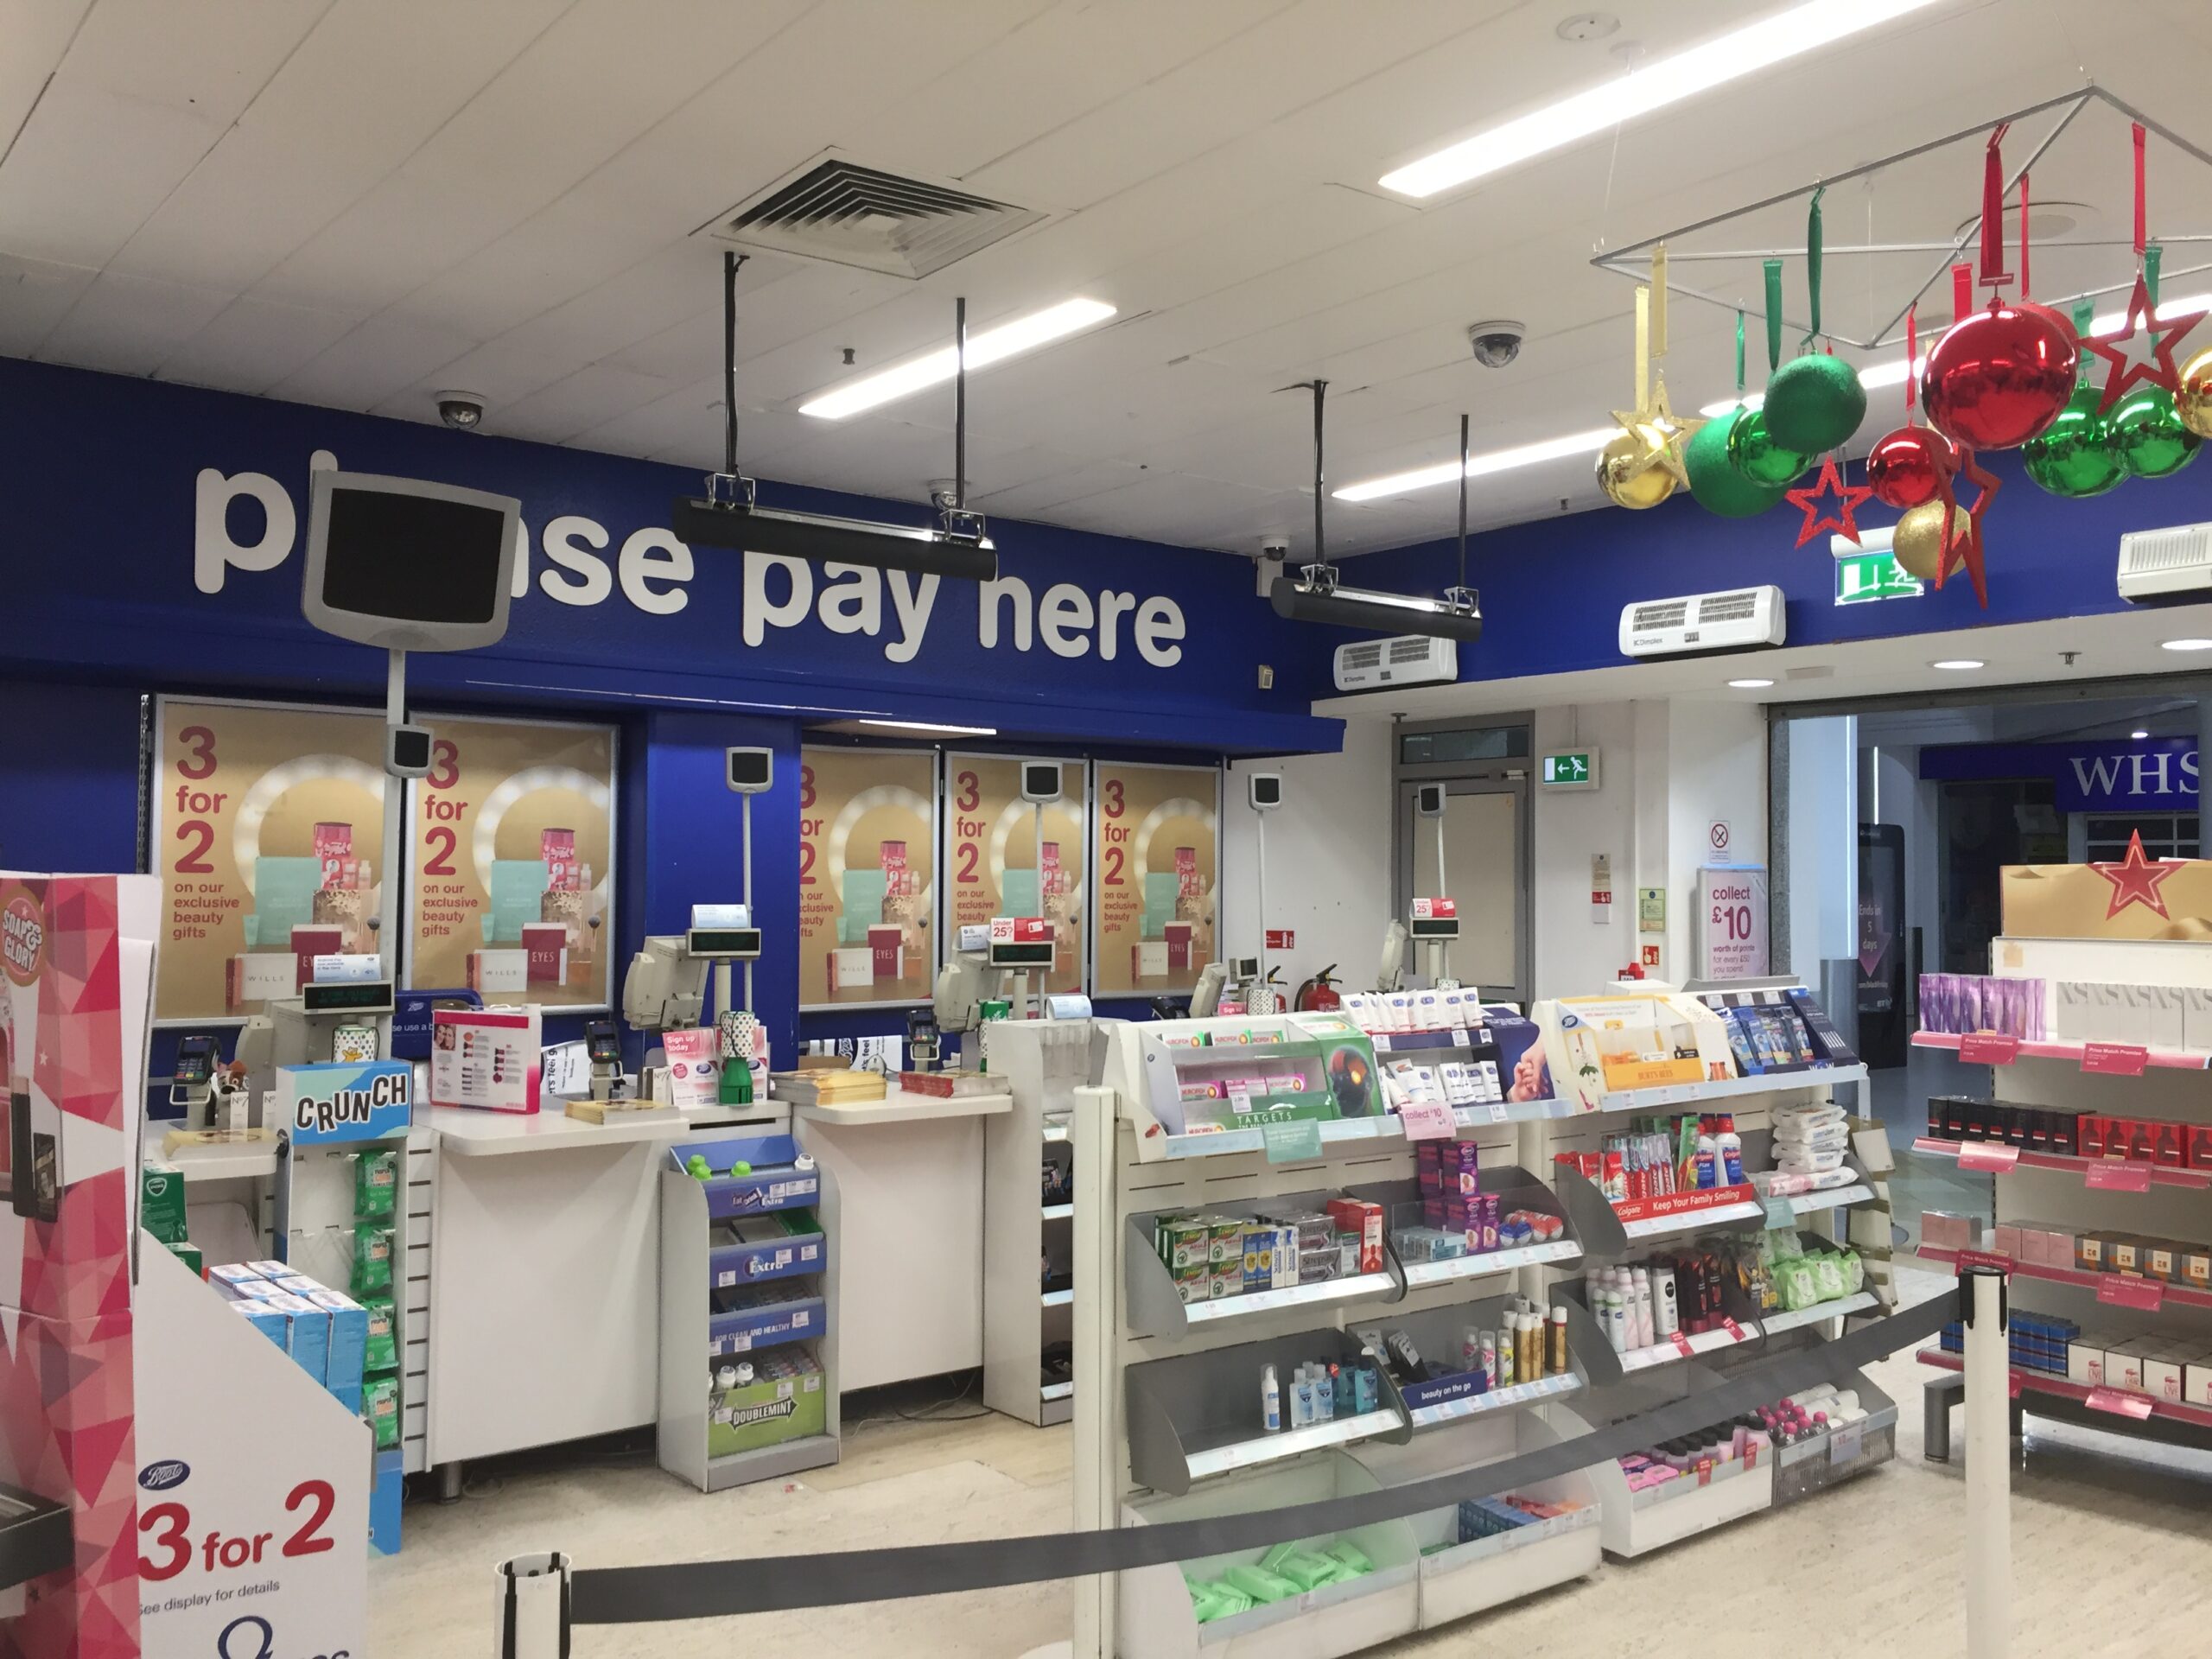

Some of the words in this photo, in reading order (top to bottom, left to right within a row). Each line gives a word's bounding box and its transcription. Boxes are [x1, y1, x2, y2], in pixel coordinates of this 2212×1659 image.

[194, 449, 694, 614] pse
[743, 550, 941, 663] pay
[979, 575, 1185, 667] here
[176, 725, 218, 779] 3
[428, 739, 460, 790] 3
[957, 771, 980, 812] 3
[1104, 779, 1125, 818] 3
[176, 785, 227, 814] for
[424, 795, 468, 821] for
[801, 817, 824, 836] or
[957, 817, 986, 838] for
[1104, 823, 1130, 842] for
[175, 820, 214, 874] 2
[423, 826, 456, 875] 2
[957, 842, 979, 883] 2
[1104, 847, 1124, 885] 2
[175, 884, 194, 893] on
[199, 884, 224, 893] our
[423, 884, 439, 893] on
[443, 884, 465, 893] our
[1713, 886, 1751, 900] collect
[174, 896, 239, 908] exclusive
[423, 896, 479, 907] exclusive
[807, 892, 823, 900] our
[957, 900, 995, 909] exclusive
[174, 912, 224, 925] beauty
[423, 910, 465, 924] beauty
[957, 912, 986, 922] beauty
[1104, 912, 1130, 923] beauty
[1712, 906, 1751, 940] £10
[3, 910, 27, 939] SOAP
[422, 925, 450, 938] gifts
[1104, 923, 1121, 933] gifts
[1866, 921, 1872, 932] 5
[173, 926, 207, 940] gifts
[994, 926, 1014, 938] 25?
[1862, 938, 1878, 951] days
[4, 937, 35, 973] GLORY
[532, 951, 555, 963] EYES
[875, 949, 893, 959] EYES
[667, 1035, 683, 1045] Sign
[686, 1035, 695, 1044] up
[669, 1043, 689, 1052] today
[296, 1073, 407, 1132] CRUNCH
[1236, 1111, 1293, 1125] TARGETS
[1406, 1110, 1428, 1119] collect
[762, 1198, 784, 1206] Extra
[1653, 1198, 1671, 1212] Keep
[1673, 1198, 1690, 1210] Your
[1691, 1193, 1713, 1208] Family
[1714, 1189, 1740, 1205] Smiling
[1618, 1205, 1642, 1218] Colgate
[751, 1328, 762, 1337] AND
[764, 1323, 790, 1334] HEALTHY
[1421, 1388, 1442, 1401] beauty
[1463, 1383, 1471, 1392] go
[733, 1400, 792, 1426] DOUBLEMINT
[143, 1464, 183, 1487] Boots
[138, 1502, 192, 1581] 3
[201, 1531, 273, 1572] for
[283, 1479, 335, 1557] 2
[164, 1594, 213, 1613] display
[216, 1588, 233, 1602] for
[238, 1580, 280, 1599] details
